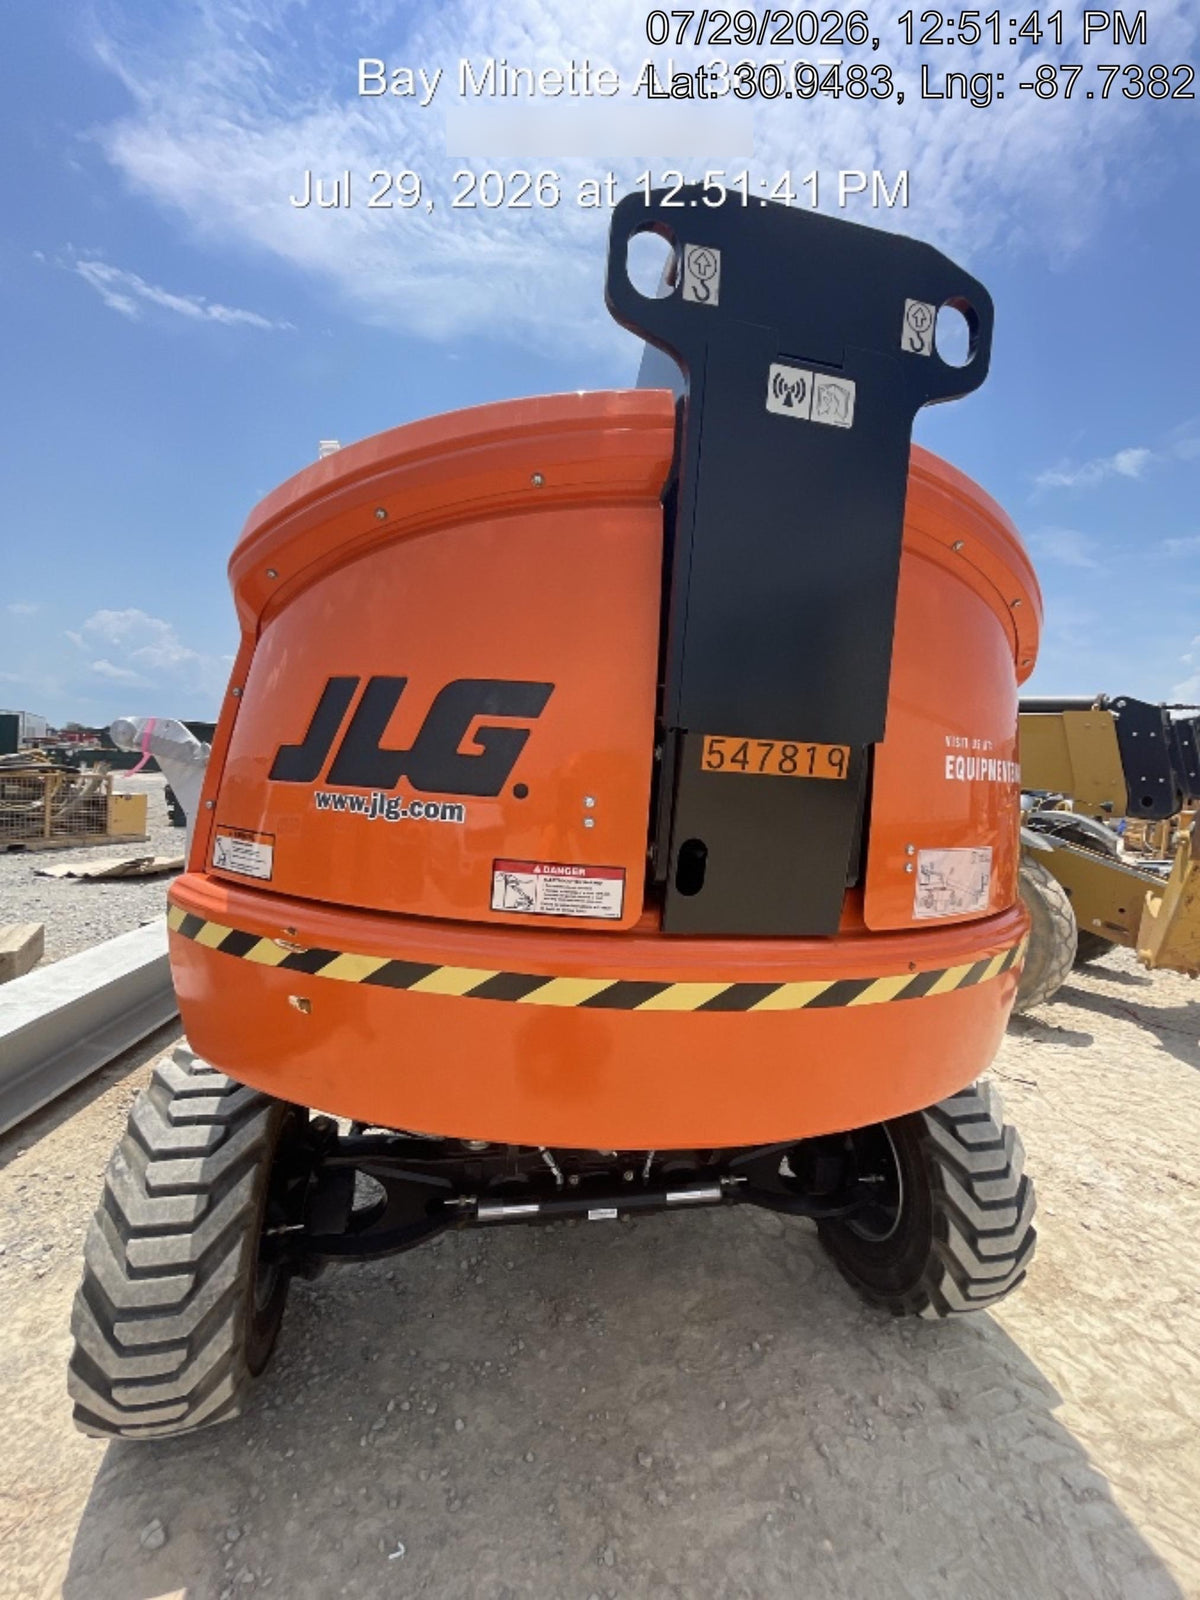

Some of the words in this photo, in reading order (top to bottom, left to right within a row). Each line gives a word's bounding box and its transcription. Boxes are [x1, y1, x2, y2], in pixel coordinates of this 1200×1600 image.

[705, 738, 846, 778] 547819
[314, 791, 466, 823] www.jlg.com
[543, 865, 586, 876] DANGER
